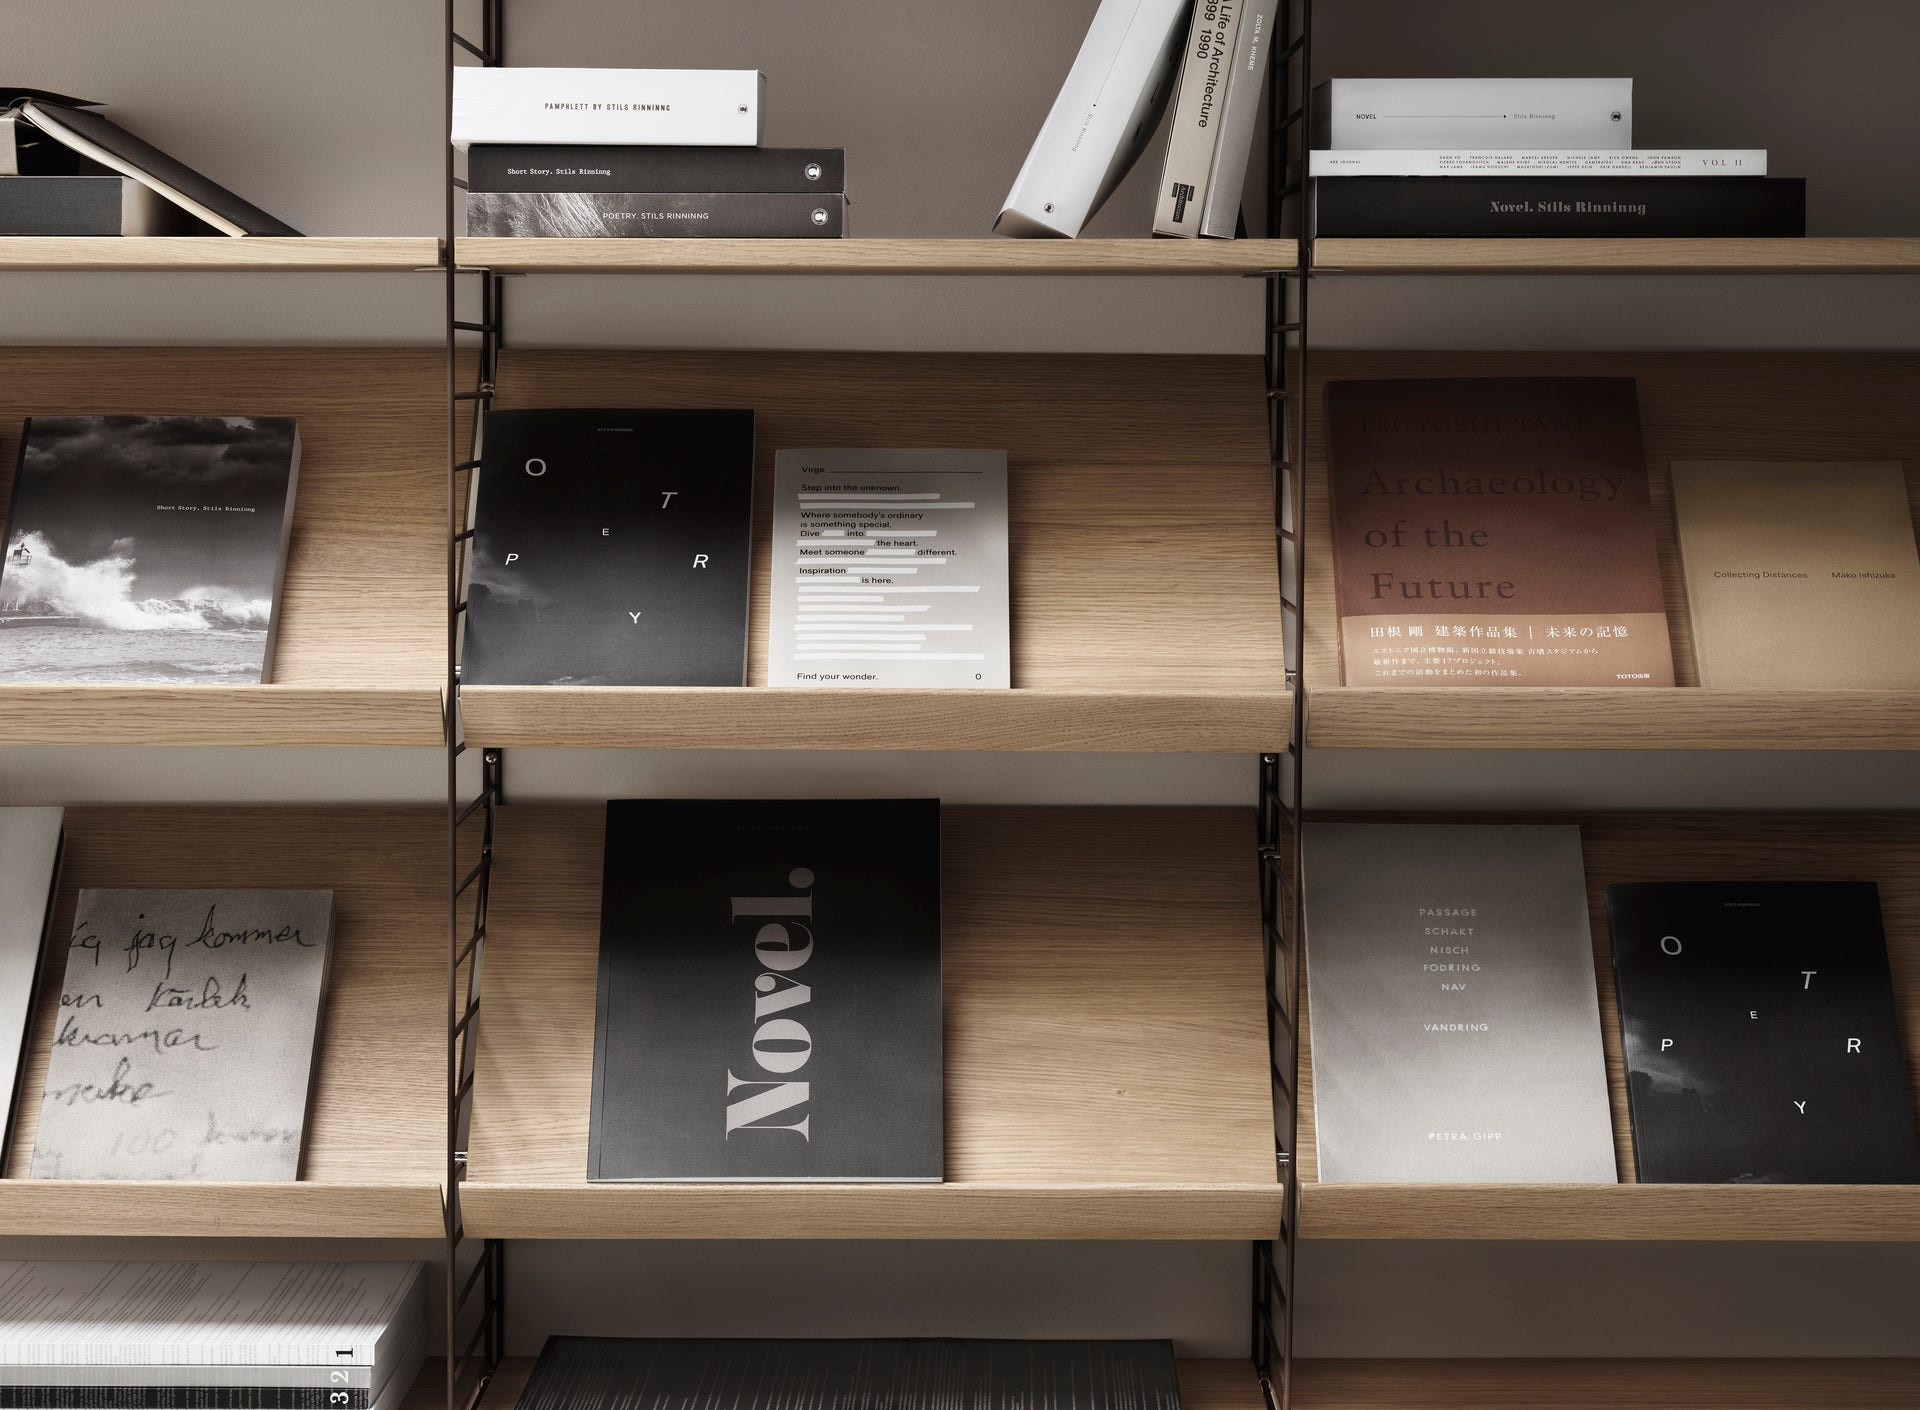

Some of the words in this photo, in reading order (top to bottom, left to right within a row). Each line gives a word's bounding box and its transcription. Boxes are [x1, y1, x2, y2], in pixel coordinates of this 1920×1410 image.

[1218, 5, 1232, 29] Life
[1197, 29, 1212, 59] 1990
[1215, 32, 1226, 46] of
[1199, 47, 1223, 128] Architecture
[530, 168, 553, 176] Story.
[579, 168, 611, 176] Rinninng
[1490, 201, 1533, 213] Novel.
[1538, 201, 1571, 213] Stils
[1576, 201, 1646, 216] Rinninng
[602, 212, 638, 220] POETRY.
[641, 212, 664, 220] STILS
[667, 212, 709, 220] RINNINNG
[1357, 416, 1501, 433] TSUYOSHI
[1513, 416, 1592, 433] TANE
[525, 458, 547, 476] O
[801, 466, 825, 475] Virge
[801, 484, 822, 492] Step
[1360, 468, 1625, 501] Archaeology
[661, 492, 678, 509] T
[833, 512, 886, 521] somebody's
[887, 512, 924, 521] ordinary
[602, 528, 610, 536] E
[810, 521, 856, 530] something
[858, 521, 892, 530] special.
[1364, 519, 1407, 548] of
[1423, 521, 1489, 548] the
[505, 553, 519, 566] P
[693, 554, 709, 569] R
[799, 567, 846, 576] Inspiration
[1713, 571, 1760, 580] Collecting
[1763, 571, 1808, 579] Distances
[1832, 571, 1857, 579] Mako
[1859, 571, 1896, 579] Ishizuka
[1369, 573, 1516, 600] Future
[629, 612, 641, 624] Y
[1370, 625, 1402, 638] 田根
[1408, 625, 1423, 637] 剛
[1435, 625, 1518, 639] 建築作品集
[1545, 625, 1629, 639] 未来の記憶
[797, 672, 817, 680] Find
[819, 674, 839, 682] your
[842, 672, 878, 680] wonder.
[1419, 908, 1477, 917] PASSAGE
[1424, 927, 1475, 936] SCHAKT
[123, 913, 178, 980] jag
[186, 903, 316, 949] kommer
[1660, 936, 1682, 956] O
[1430, 946, 1469, 955] NISCH
[1423, 964, 1481, 972] FODRING
[1801, 971, 1817, 989] T
[1441, 983, 1466, 991] NAV
[726, 867, 815, 1142] Novel.
[1750, 1011, 1758, 1019] E
[1423, 1023, 1489, 1032] VANDRING
[1661, 1038, 1673, 1051] P
[1847, 1038, 1861, 1053] R
[1794, 1100, 1806, 1114] Y
[1428, 1132, 1468, 1141] PETRA
[1473, 1132, 1502, 1141] GIPP
[335, 1347, 354, 1358] 1
[330, 1370, 349, 1383] 2
[330, 1391, 349, 1405] 3
